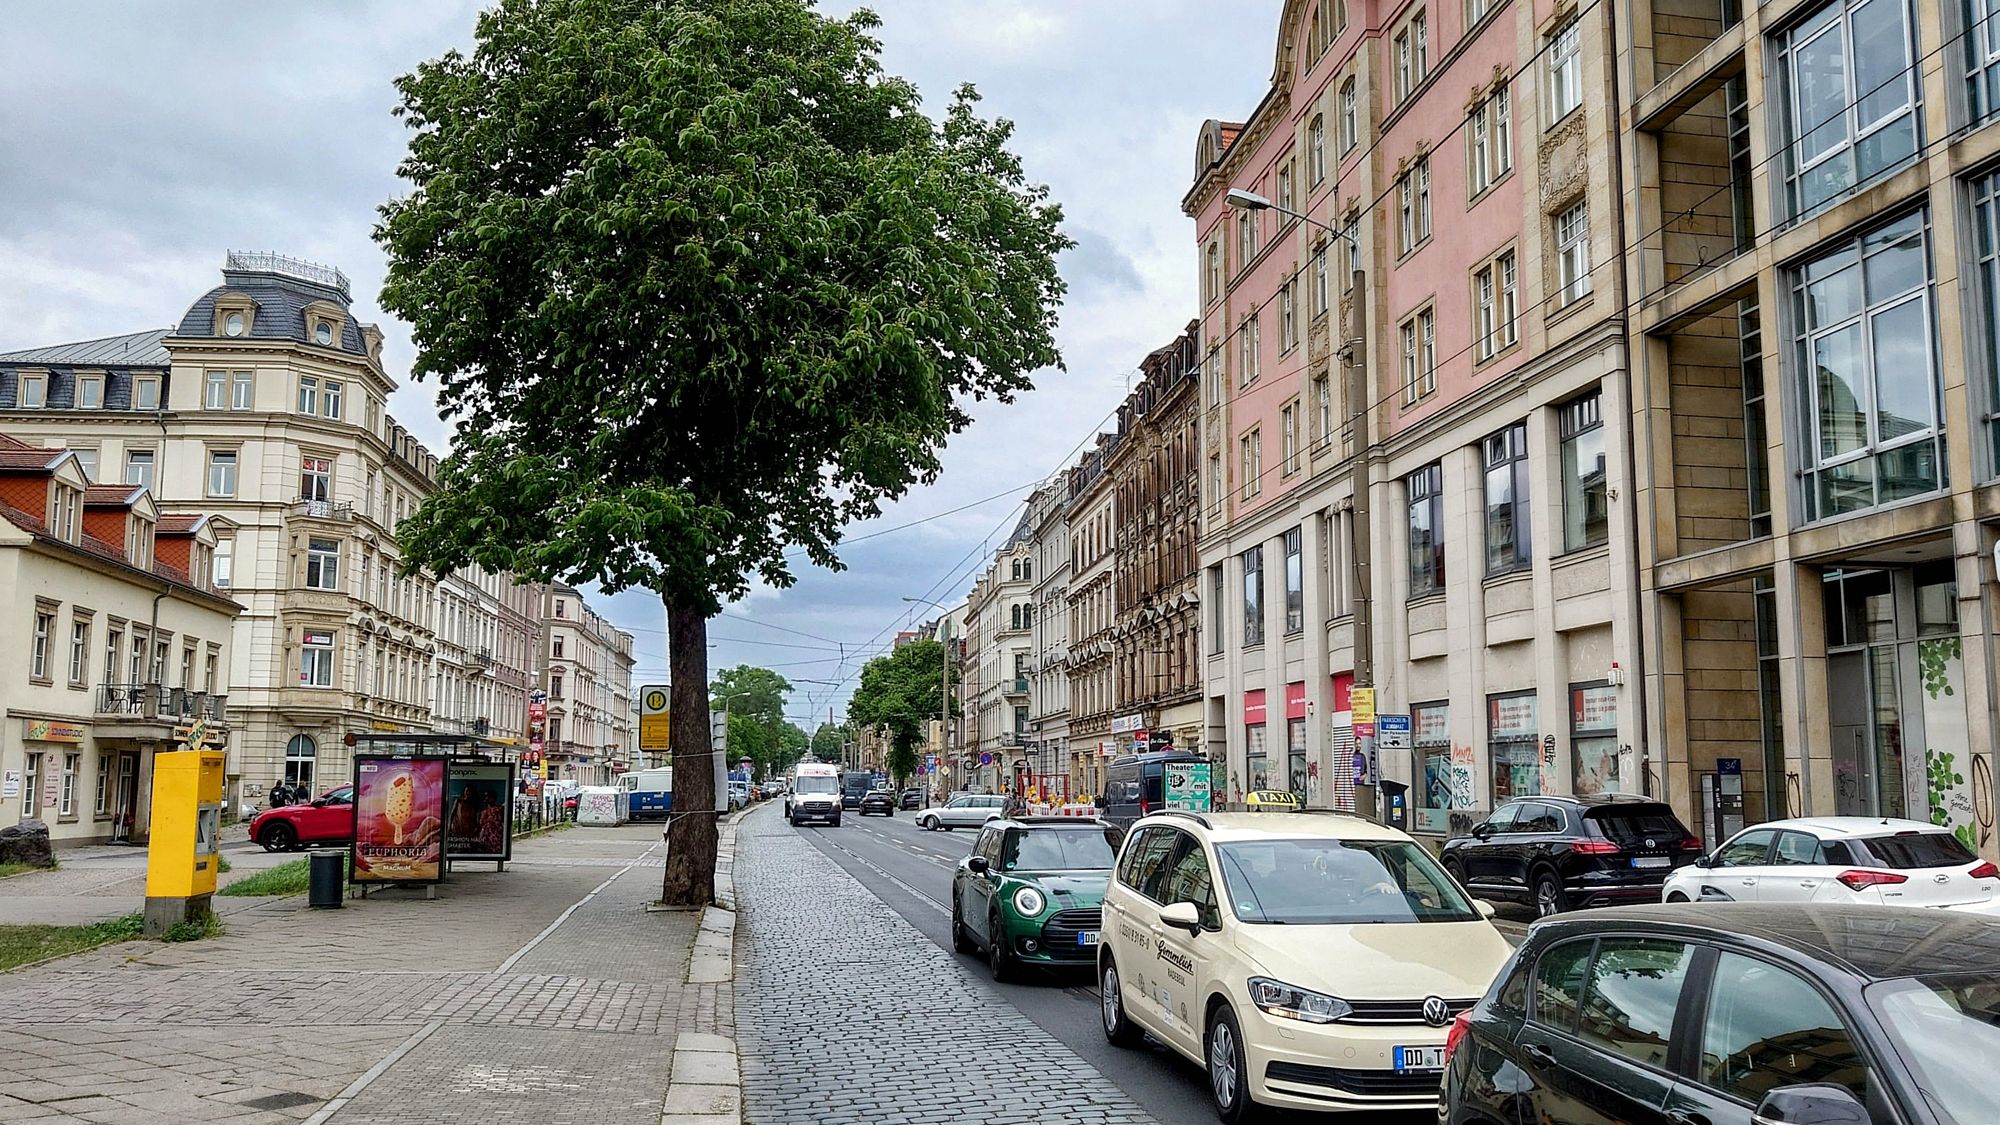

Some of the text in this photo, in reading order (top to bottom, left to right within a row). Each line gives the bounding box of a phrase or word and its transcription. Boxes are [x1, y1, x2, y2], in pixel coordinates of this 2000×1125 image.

[1166, 763, 1194, 771] Theater
[1260, 792, 1291, 803] TAXI
[1393, 796, 1400, 806] P
[368, 847, 427, 857] EUPHORIA
[1085, 933, 1096, 943] DD
[1405, 1048, 1446, 1066] DD T
